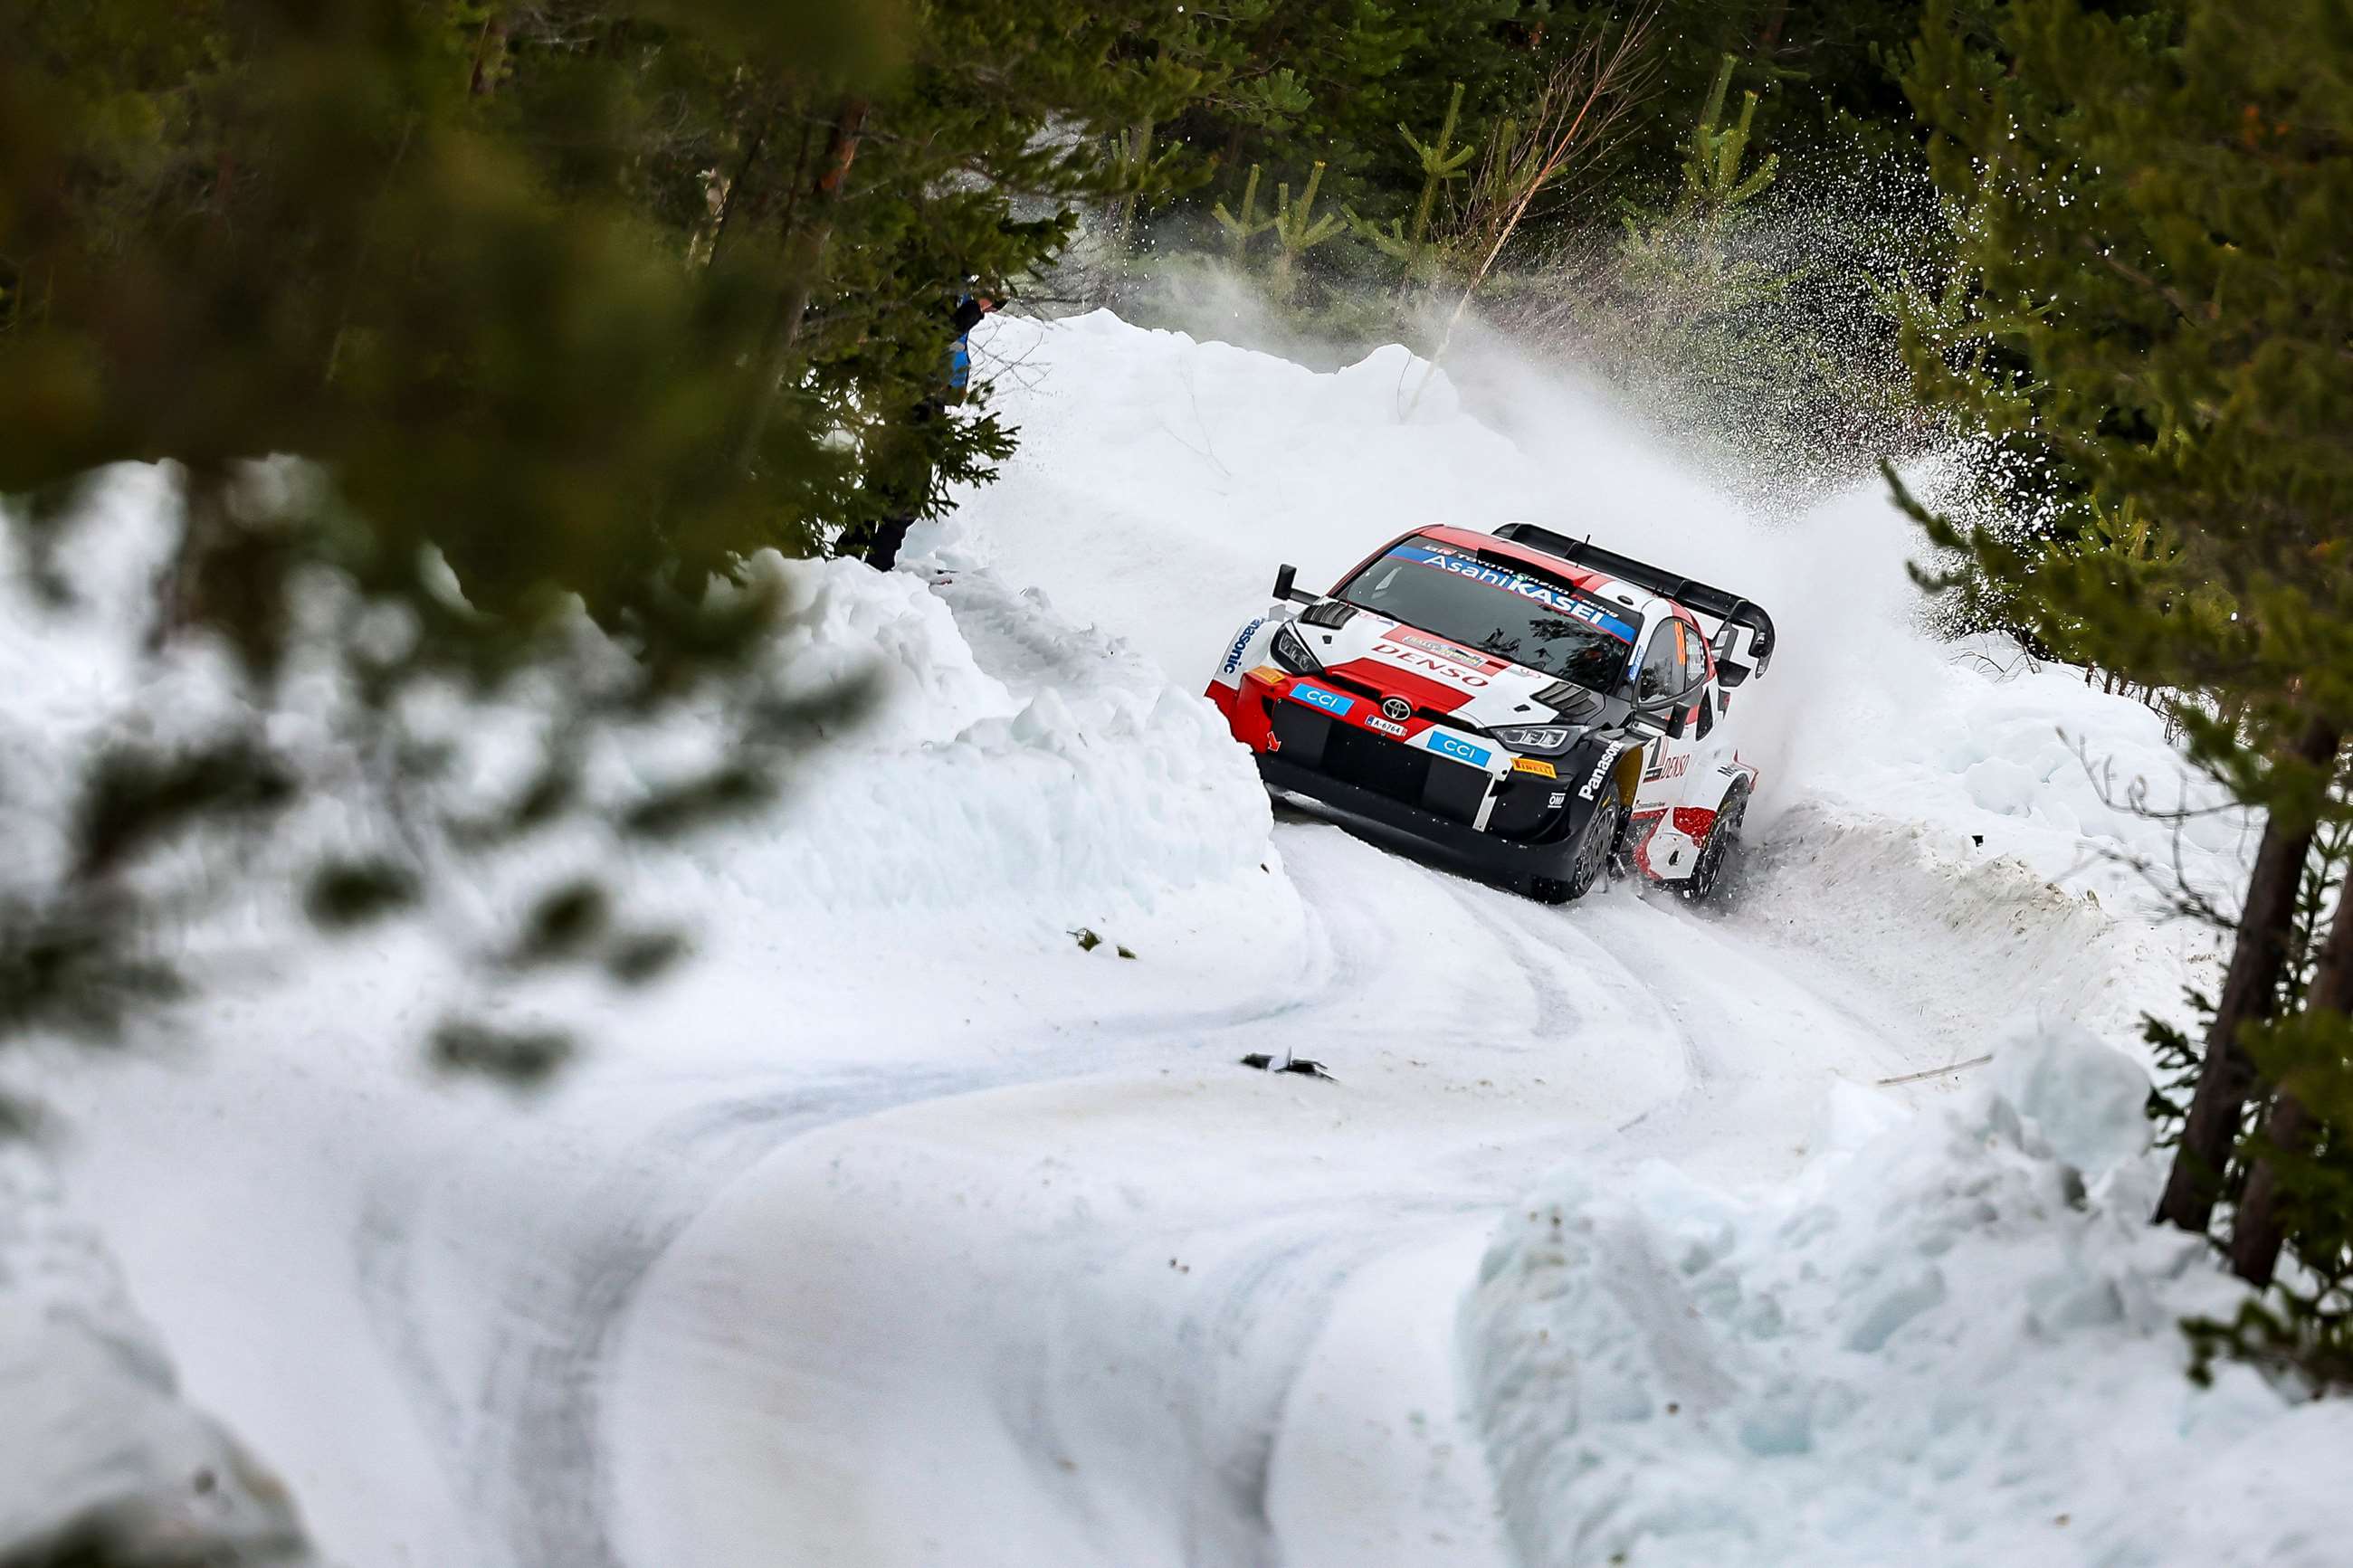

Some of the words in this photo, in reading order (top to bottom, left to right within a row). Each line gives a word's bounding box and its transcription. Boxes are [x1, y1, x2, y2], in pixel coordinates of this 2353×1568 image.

[1457, 553, 1514, 575] TOYOTA
[1517, 573, 1569, 595] GAZOO
[1571, 594, 1619, 618] Racing
[1371, 643, 1489, 688] DENSO
[1306, 690, 1338, 708] CCI
[1374, 719, 1401, 734] A-6764
[1443, 739, 1476, 758] CCI
[1514, 759, 1554, 775] PIRELLI
[1577, 740, 1624, 802] Panasoni
[1661, 753, 1691, 780] DENSO
